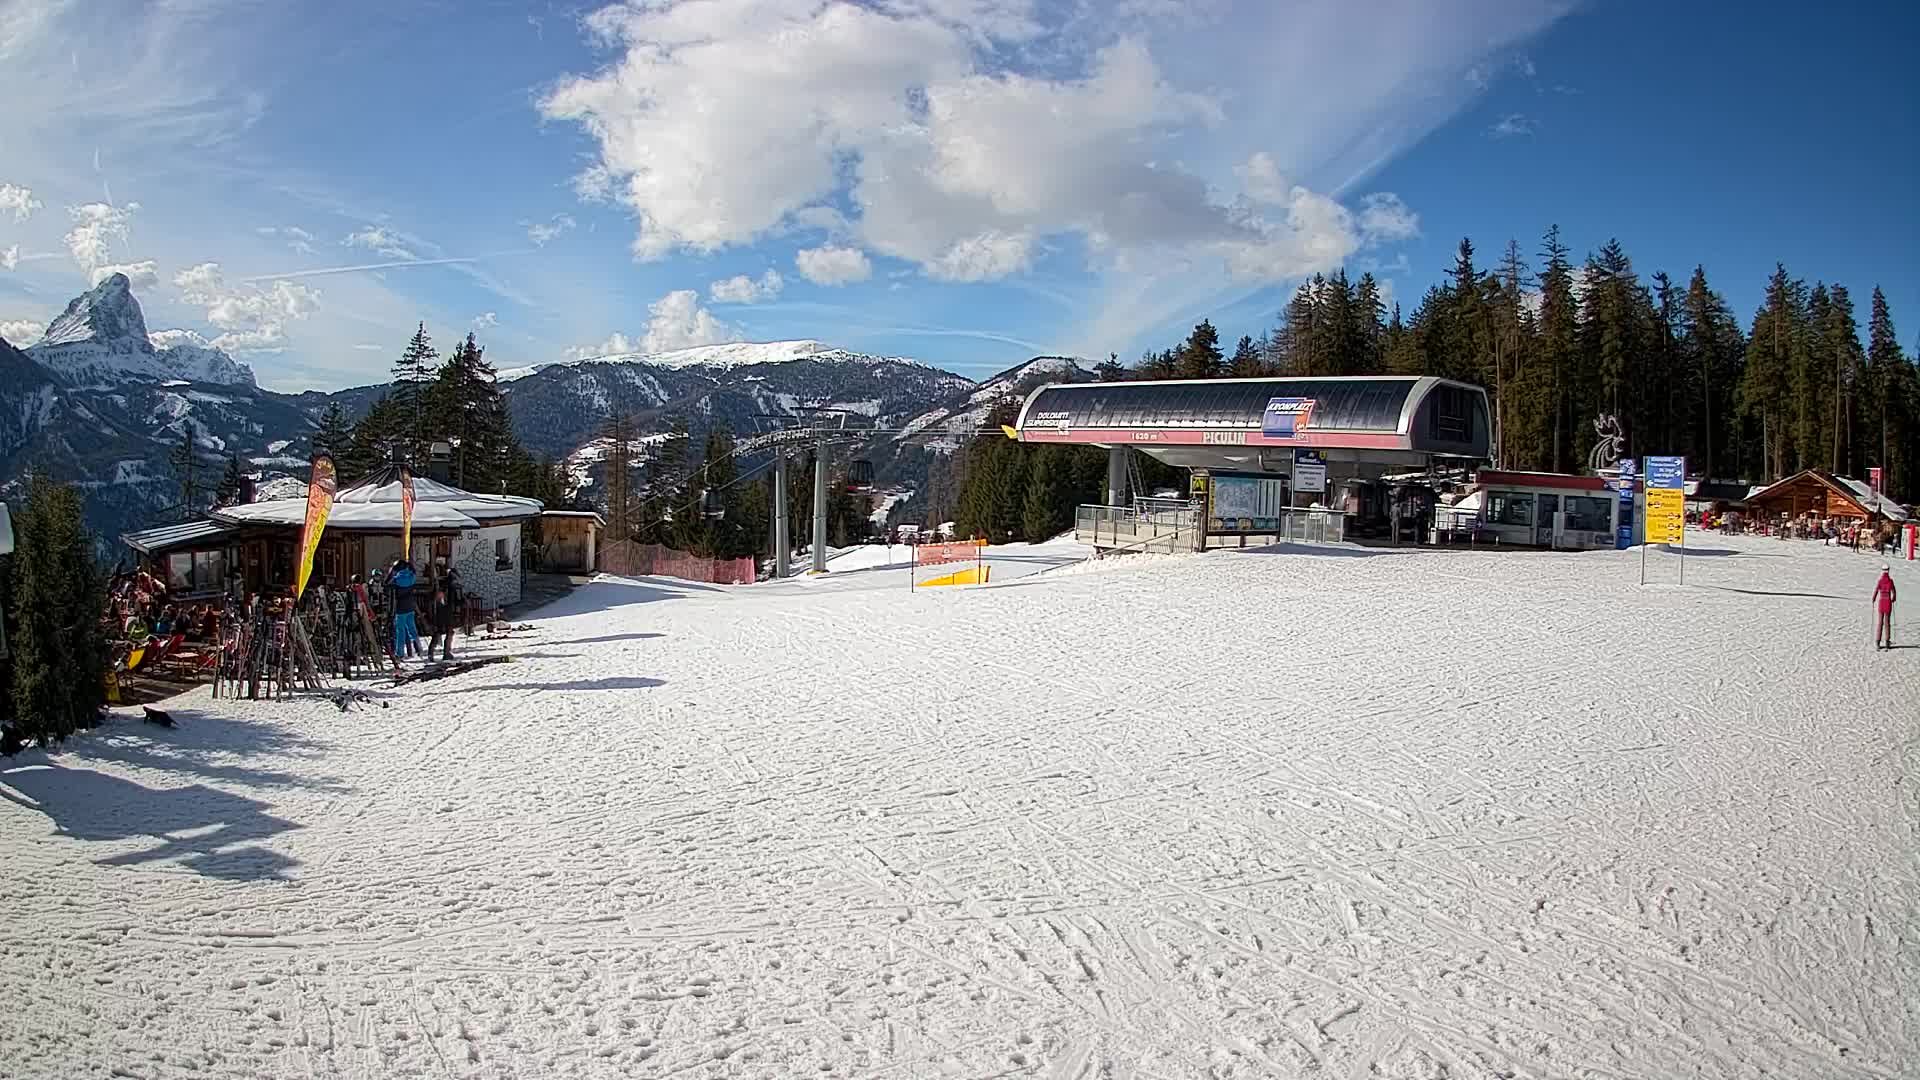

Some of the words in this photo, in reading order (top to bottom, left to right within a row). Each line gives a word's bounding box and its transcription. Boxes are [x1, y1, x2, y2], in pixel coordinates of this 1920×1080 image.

[1267, 402, 1314, 411] KRONPLATZ
[1131, 432, 1149, 440] 1620
[1202, 431, 1246, 444] PICULIN
